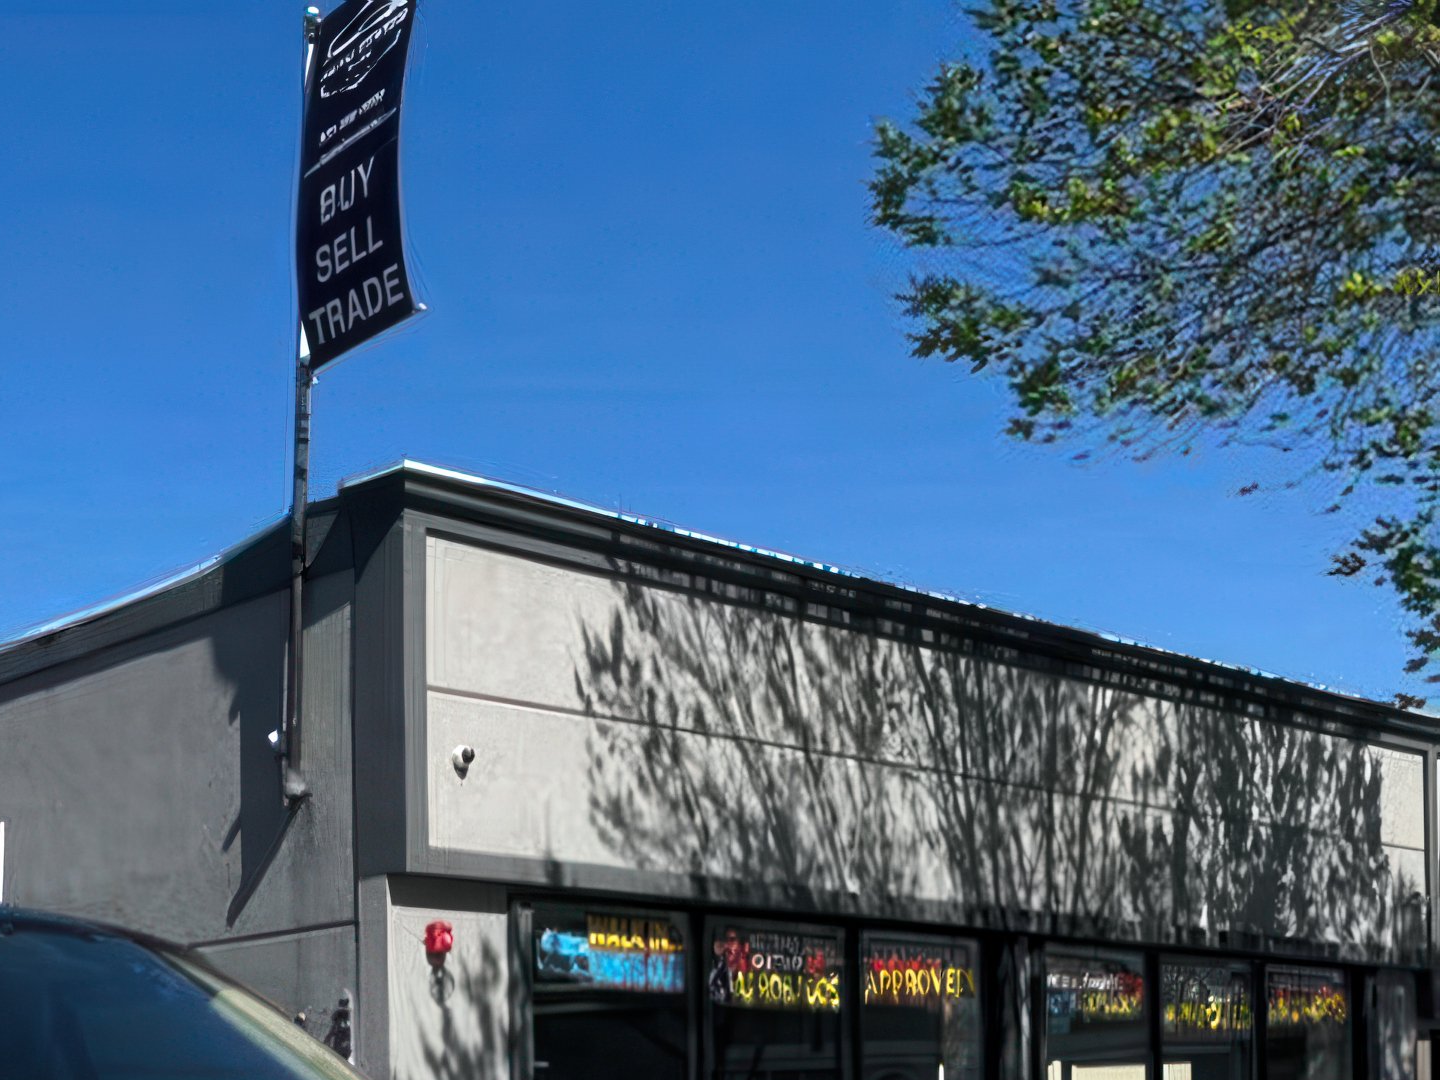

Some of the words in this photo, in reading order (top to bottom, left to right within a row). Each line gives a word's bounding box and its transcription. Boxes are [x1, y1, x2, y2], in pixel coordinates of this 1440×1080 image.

[319, 155, 375, 226] BUY
[315, 215, 384, 283] SELL
[308, 262, 405, 345] TRADE
